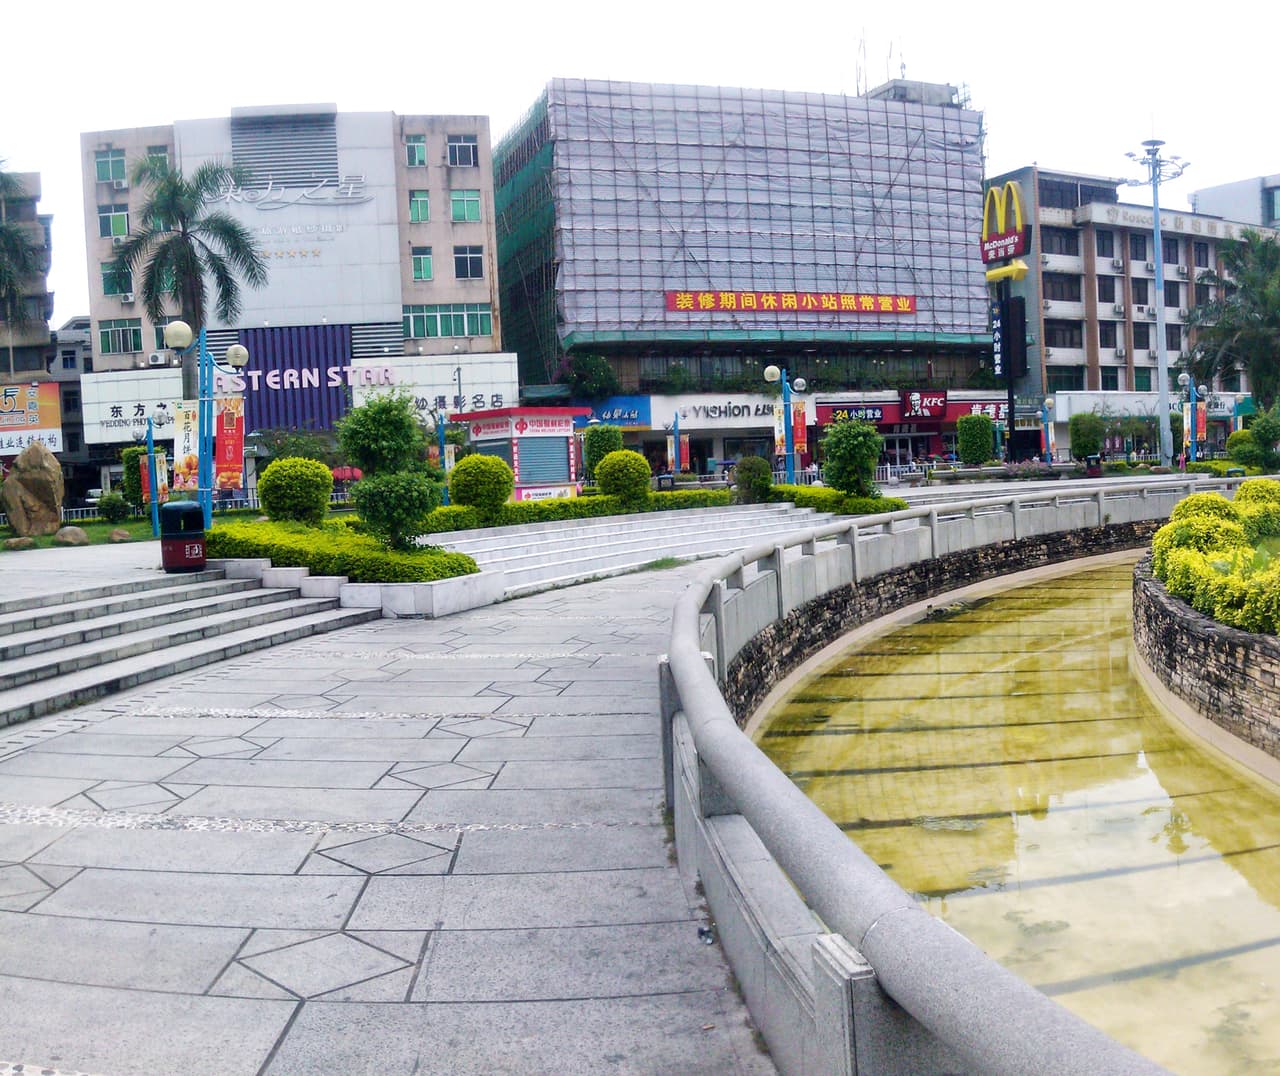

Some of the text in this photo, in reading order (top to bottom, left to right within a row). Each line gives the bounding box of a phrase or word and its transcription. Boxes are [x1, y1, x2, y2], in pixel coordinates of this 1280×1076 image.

[984, 235, 1019, 251] McDonald's
[676, 292, 912, 312] 装修期间休闲小站照常营业
[213, 365, 395, 393] ASTERN STAR
[922, 397, 945, 407] KFC
